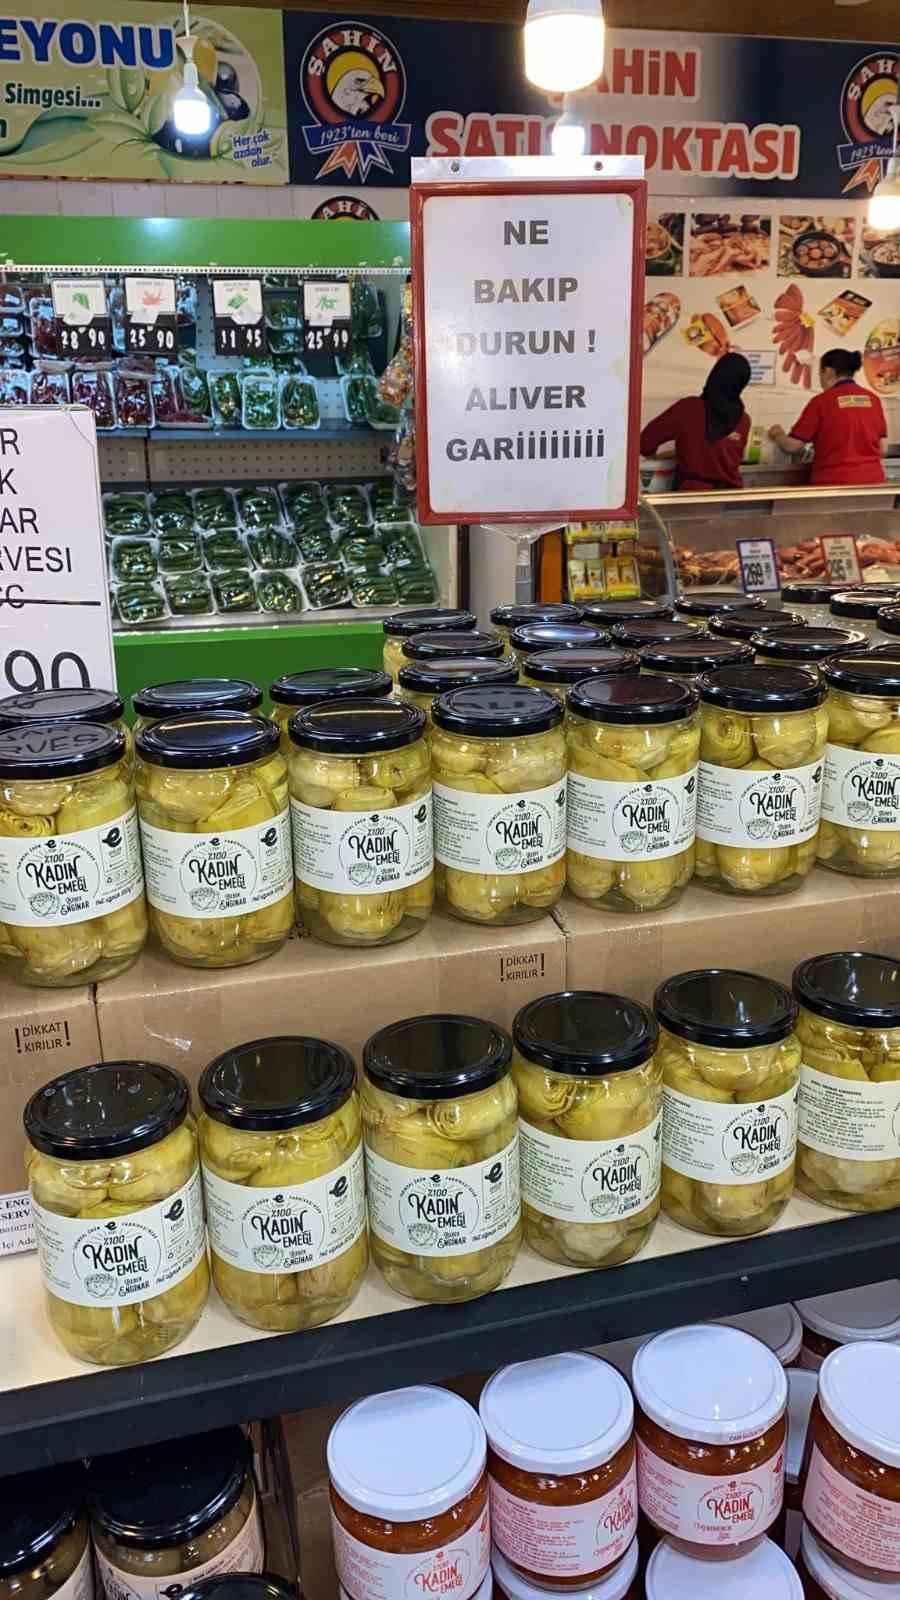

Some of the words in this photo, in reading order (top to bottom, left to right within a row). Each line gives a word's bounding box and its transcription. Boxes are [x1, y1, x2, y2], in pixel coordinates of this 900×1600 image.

[596, 48, 697, 97] HİN
[5, 83, 101, 108] Simgesi...
[431, 116, 556, 157] SATI
[590, 123, 795, 174] NOKTASI
[503, 220, 549, 246] NE
[473, 276, 579, 304] BAKIP
[455, 330, 575, 356] DURUN
[464, 384, 587, 411] ALIVER
[750, 788, 797, 817] KADIN
[851, 774, 900, 801] KADIN
[622, 800, 669, 829] KADIN
[348, 829, 398, 861] KADIN
[496, 814, 542, 846] KADIN
[26, 855, 81, 890] KADIN
[189, 854, 241, 886] KADIN
[22, 1021, 62, 1038] DİKKAT
[24, 1038, 63, 1053] KIRILIR
[733, 1117, 780, 1151] KADIN
[592, 1156, 641, 1192] KADIN
[407, 1191, 463, 1223] KADIN
[251, 1210, 308, 1243] KADIN
[83, 1236, 142, 1272] KADIN
[706, 1491, 754, 1520] KADIN
